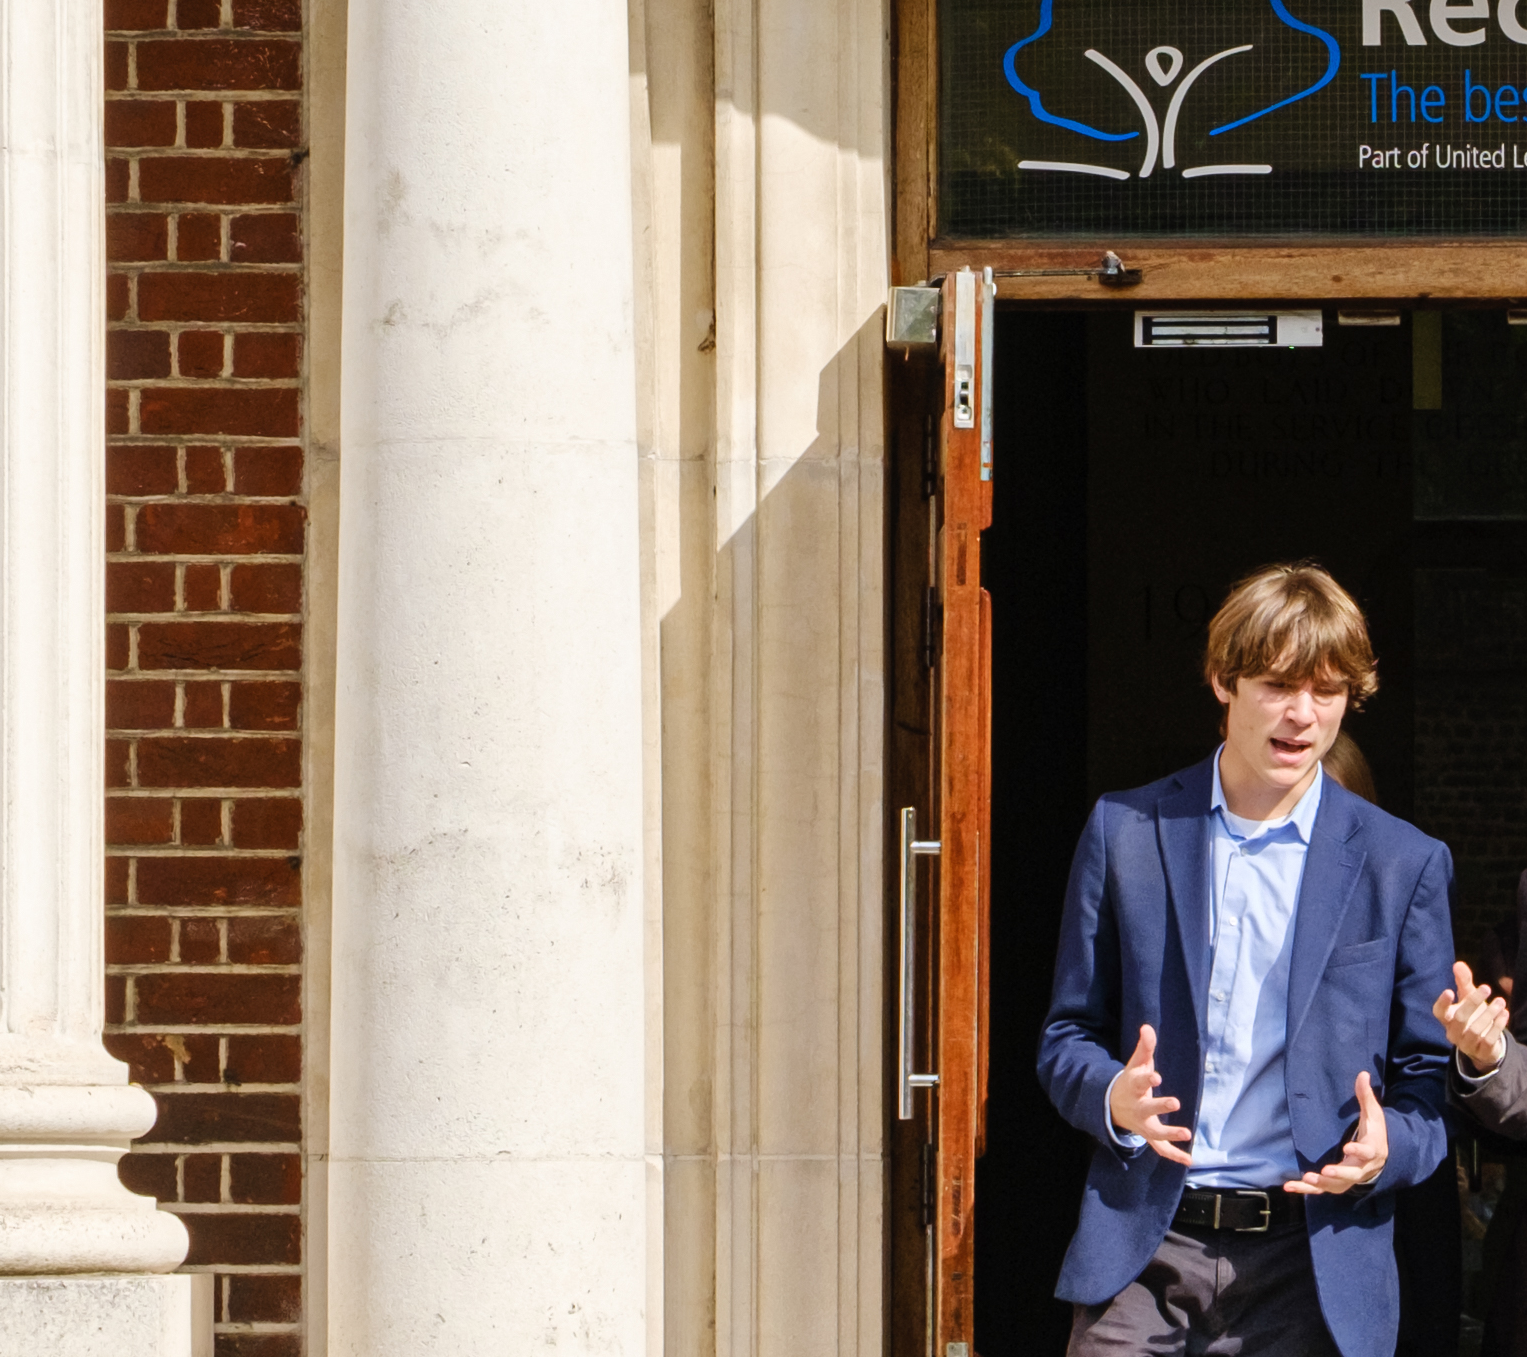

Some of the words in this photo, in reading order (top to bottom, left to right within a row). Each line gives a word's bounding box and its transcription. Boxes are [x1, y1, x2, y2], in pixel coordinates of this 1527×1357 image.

[1360, 69, 1446, 123] The
[1359, 144, 1402, 169] Part
[1407, 142, 1430, 169] of
[1435, 142, 1505, 169] United
